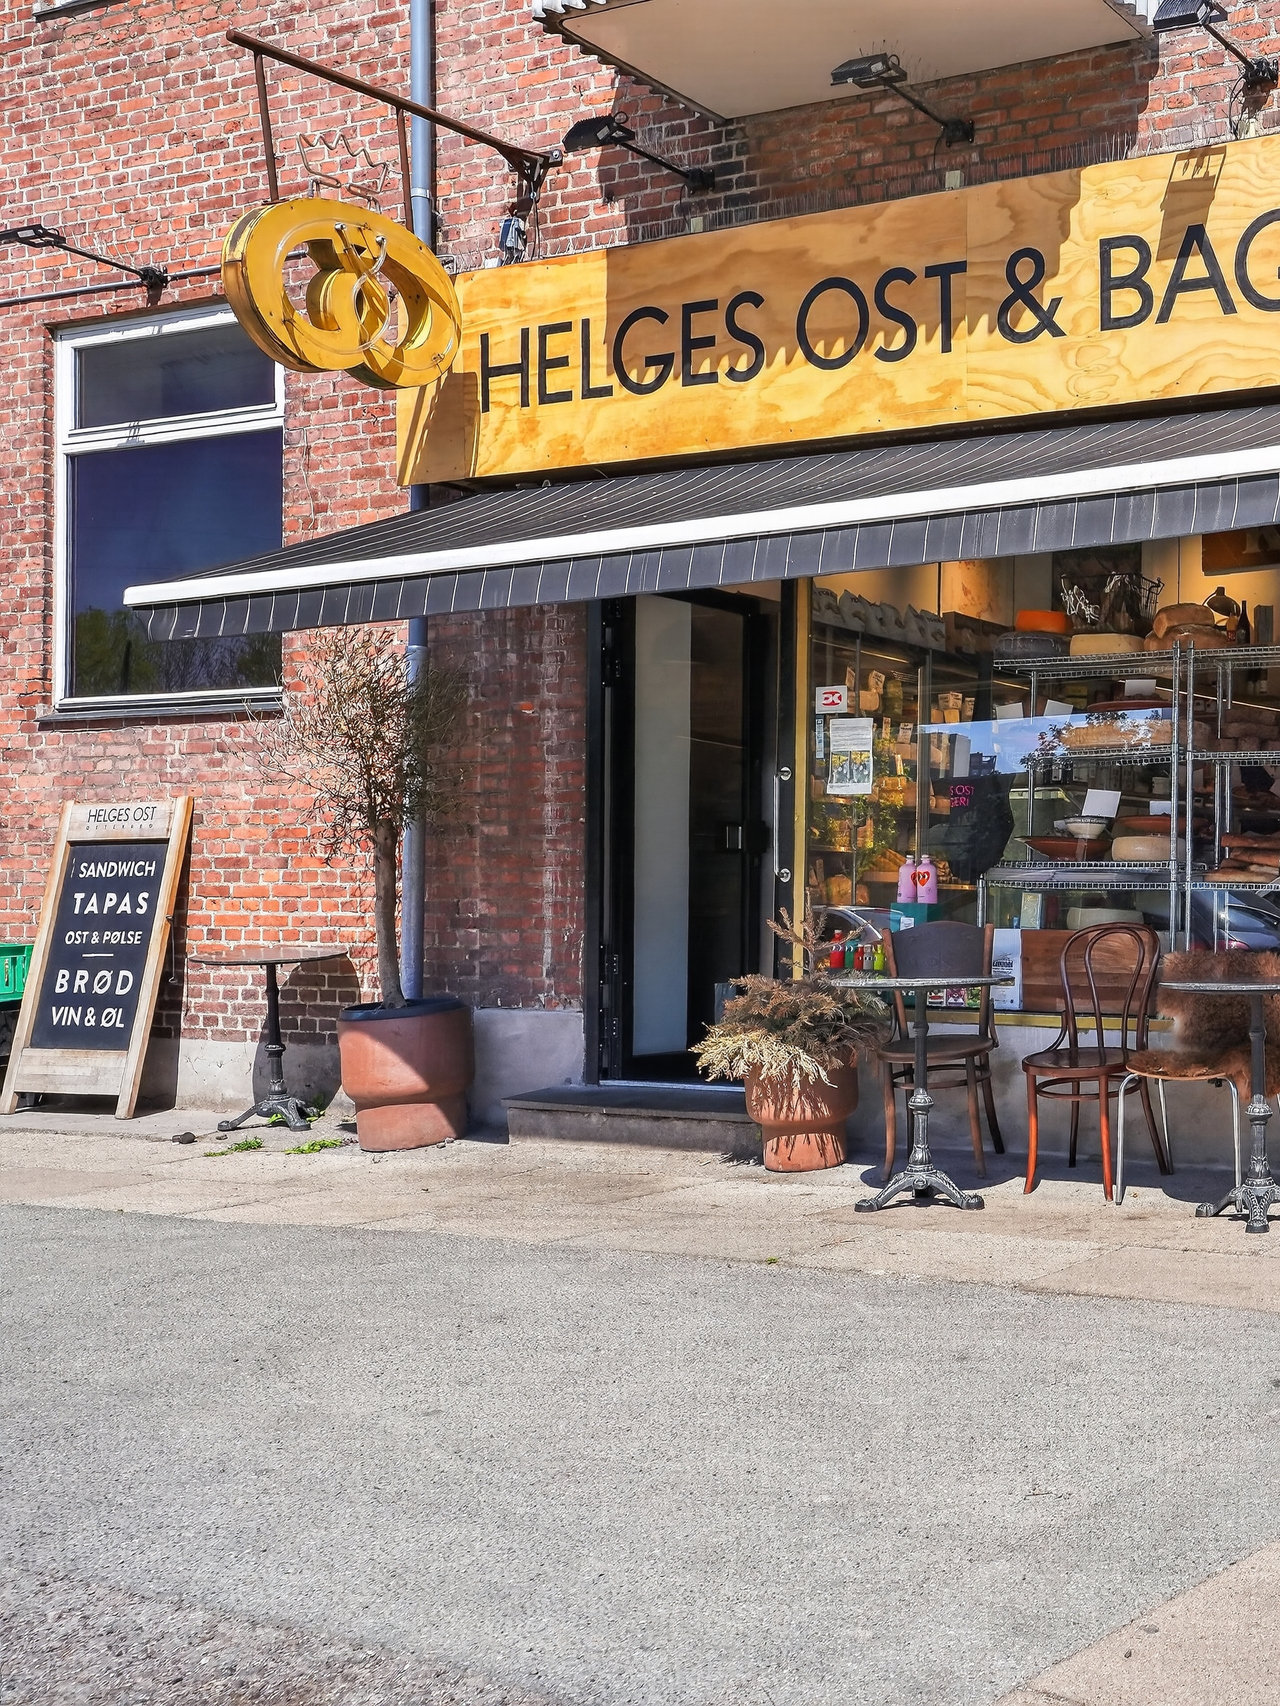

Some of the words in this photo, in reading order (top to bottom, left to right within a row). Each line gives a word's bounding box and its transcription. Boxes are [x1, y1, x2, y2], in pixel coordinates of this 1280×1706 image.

[480, 290, 766, 413] HELGES
[796, 259, 968, 370] OST
[996, 246, 1068, 344] &
[87, 807, 131, 823] HELGES
[132, 806, 157, 822] OST
[79, 860, 156, 879] SANDWICH
[73, 891, 150, 915] TAPAS
[64, 931, 89, 945] OST
[90, 930, 100, 945] &
[102, 930, 143, 945] PØLSE
[54, 969, 134, 996] BRØD
[51, 1005, 82, 1027] VIN
[84, 1005, 96, 1027] &
[99, 1006, 125, 1029] ØL
